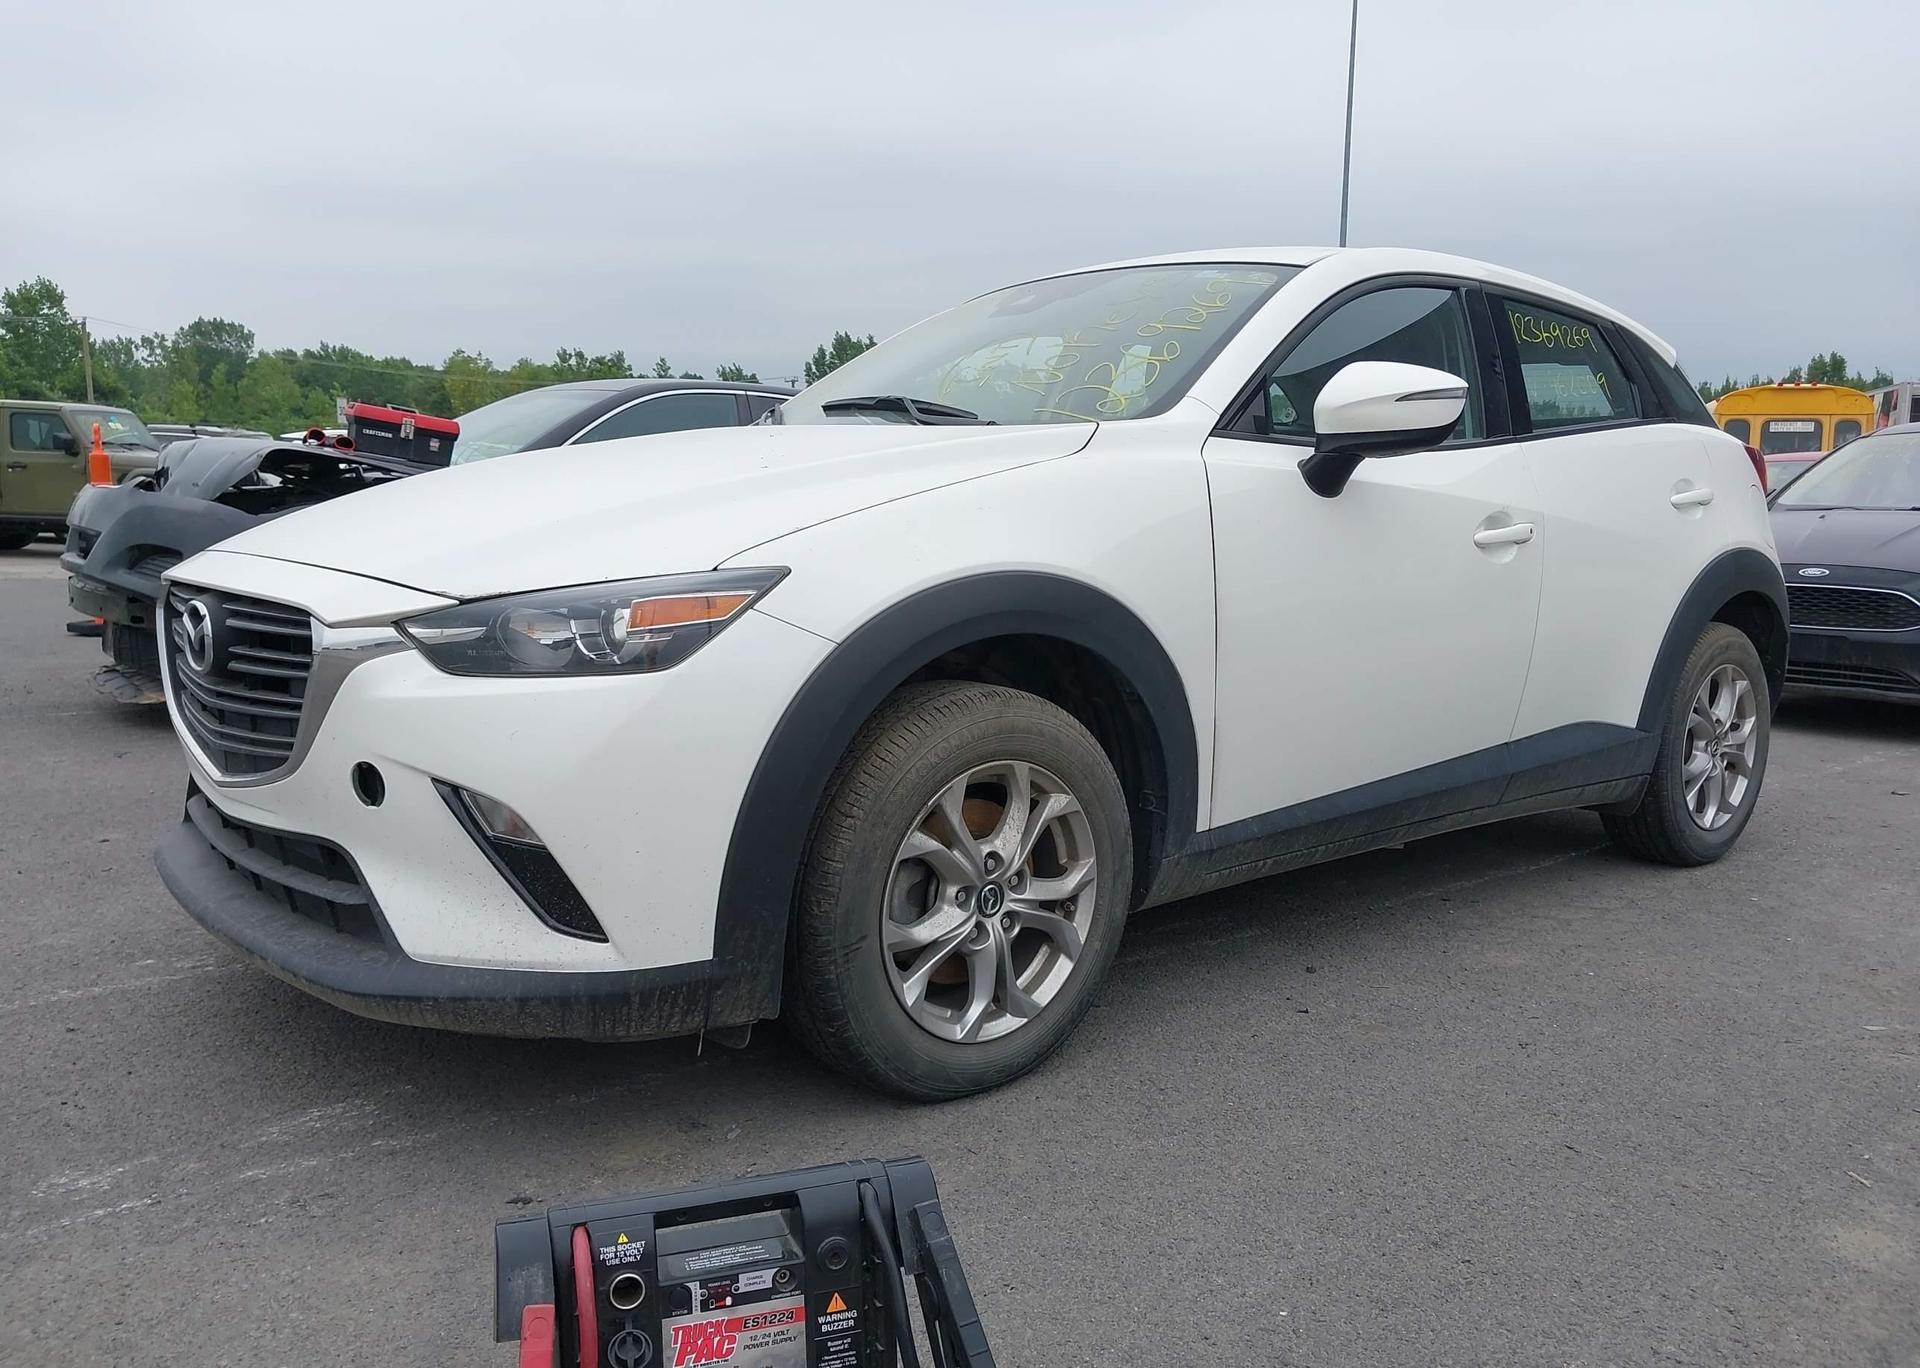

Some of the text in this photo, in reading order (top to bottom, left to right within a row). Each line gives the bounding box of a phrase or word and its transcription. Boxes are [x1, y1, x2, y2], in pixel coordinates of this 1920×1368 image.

[1508, 310, 1598, 353] 12369269
[362, 428, 393, 439] CRAFTSMAN
[600, 1241, 646, 1254] THIS SOCKET
[600, 1253, 615, 1261] FOR
[625, 1247, 644, 1256] VOLT
[606, 1254, 641, 1266] USE ONLY
[817, 1309, 858, 1324] WARNING
[672, 1310, 794, 1346] TRUCK ES1224
[821, 1319, 855, 1332] BUZZER
[749, 1329, 791, 1342] 12/24 VOLT
[743, 1335, 798, 1351] POWER SUPPLY
[674, 1334, 737, 1368] PAC
